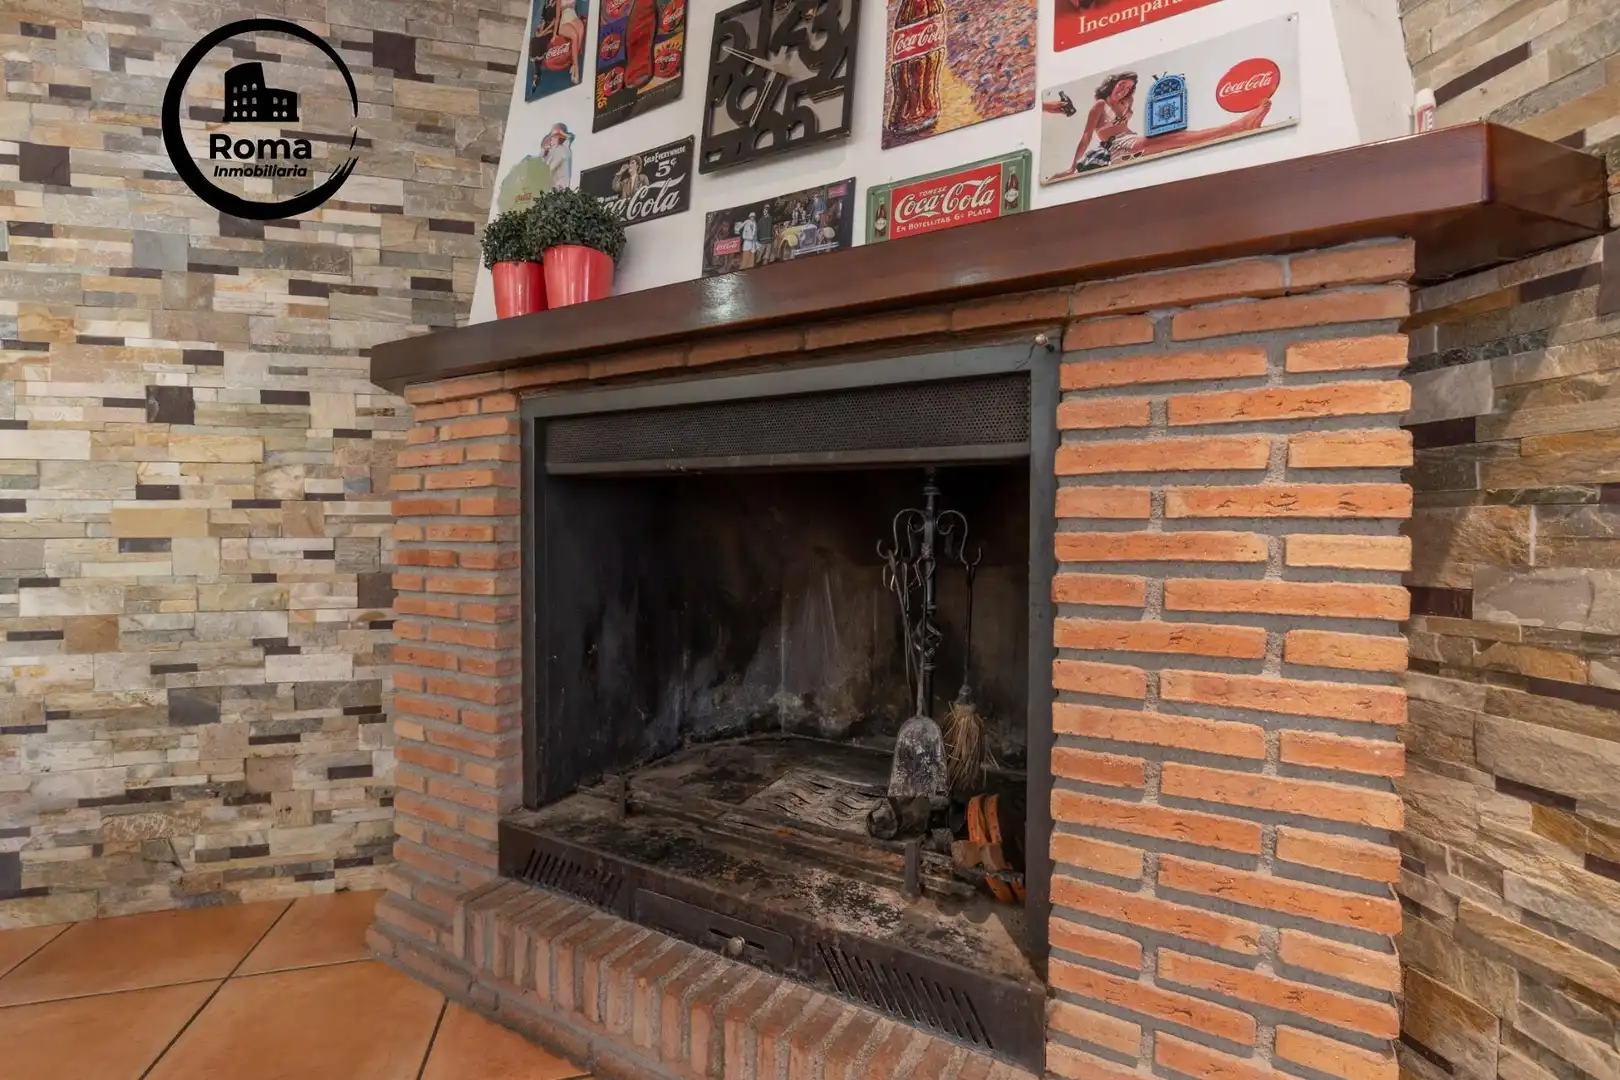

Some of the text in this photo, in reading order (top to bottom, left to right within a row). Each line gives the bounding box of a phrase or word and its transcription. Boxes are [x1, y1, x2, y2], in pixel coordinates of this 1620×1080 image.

[1078, 0, 1182, 35] Incompar
[1219, 71, 1274, 98] Coca-Cola
[919, 185, 948, 197] TOMESE
[908, 217, 951, 231] BOTELLITAS
[967, 207, 993, 219] PLATA
